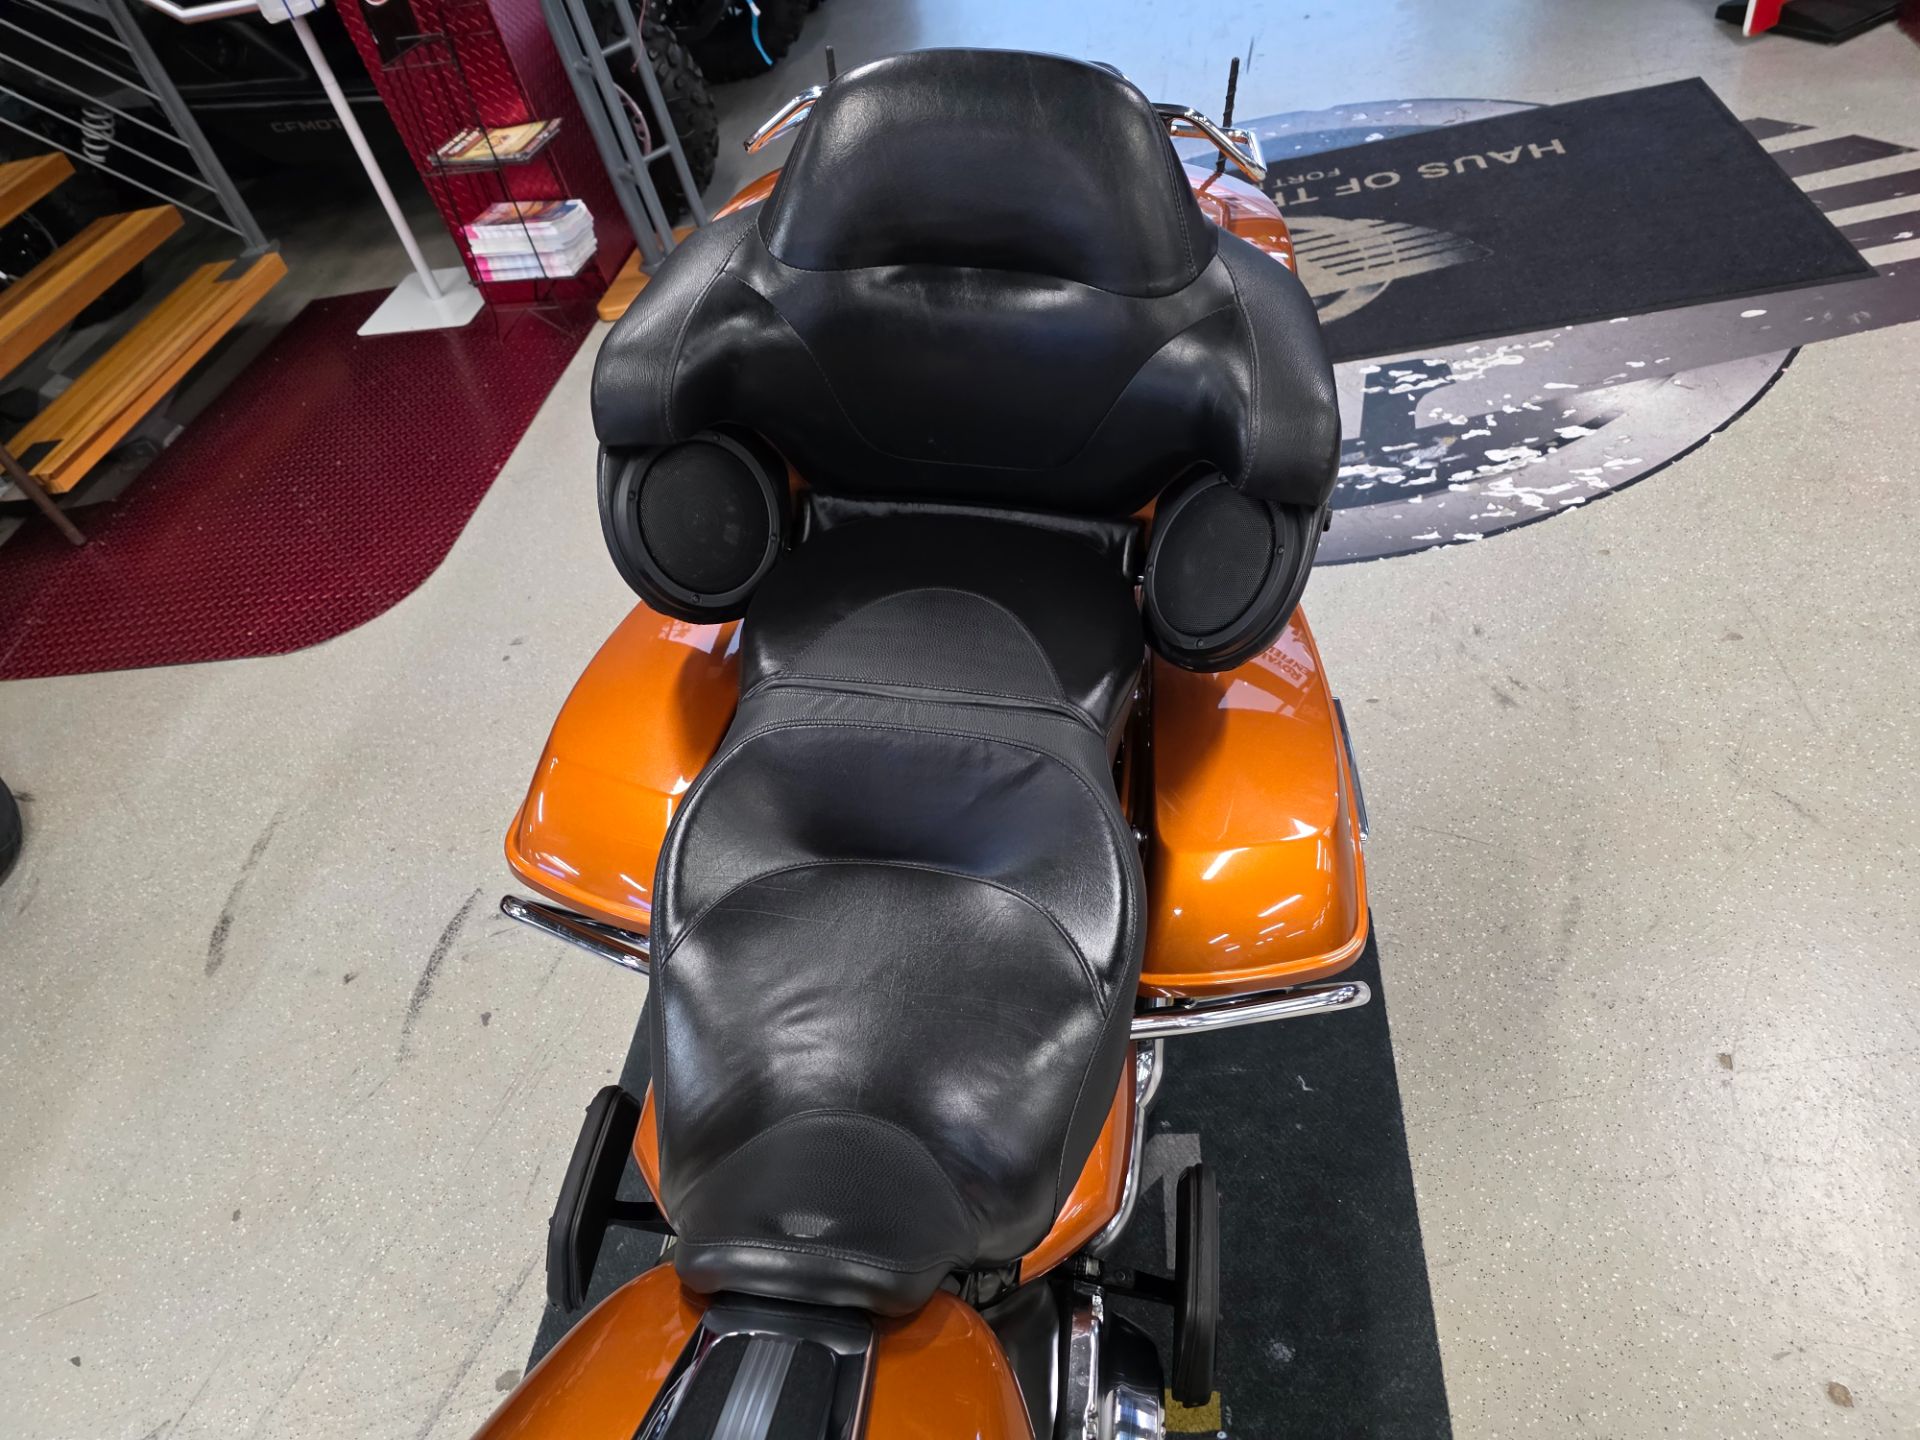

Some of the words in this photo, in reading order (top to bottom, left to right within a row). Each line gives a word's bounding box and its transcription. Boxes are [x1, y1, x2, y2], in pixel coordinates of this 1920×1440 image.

[270, 118, 343, 133] CFMOT
[1417, 138, 1567, 180] HAUS
[1272, 167, 1341, 189] FORT
[1335, 171, 1401, 197] OF
